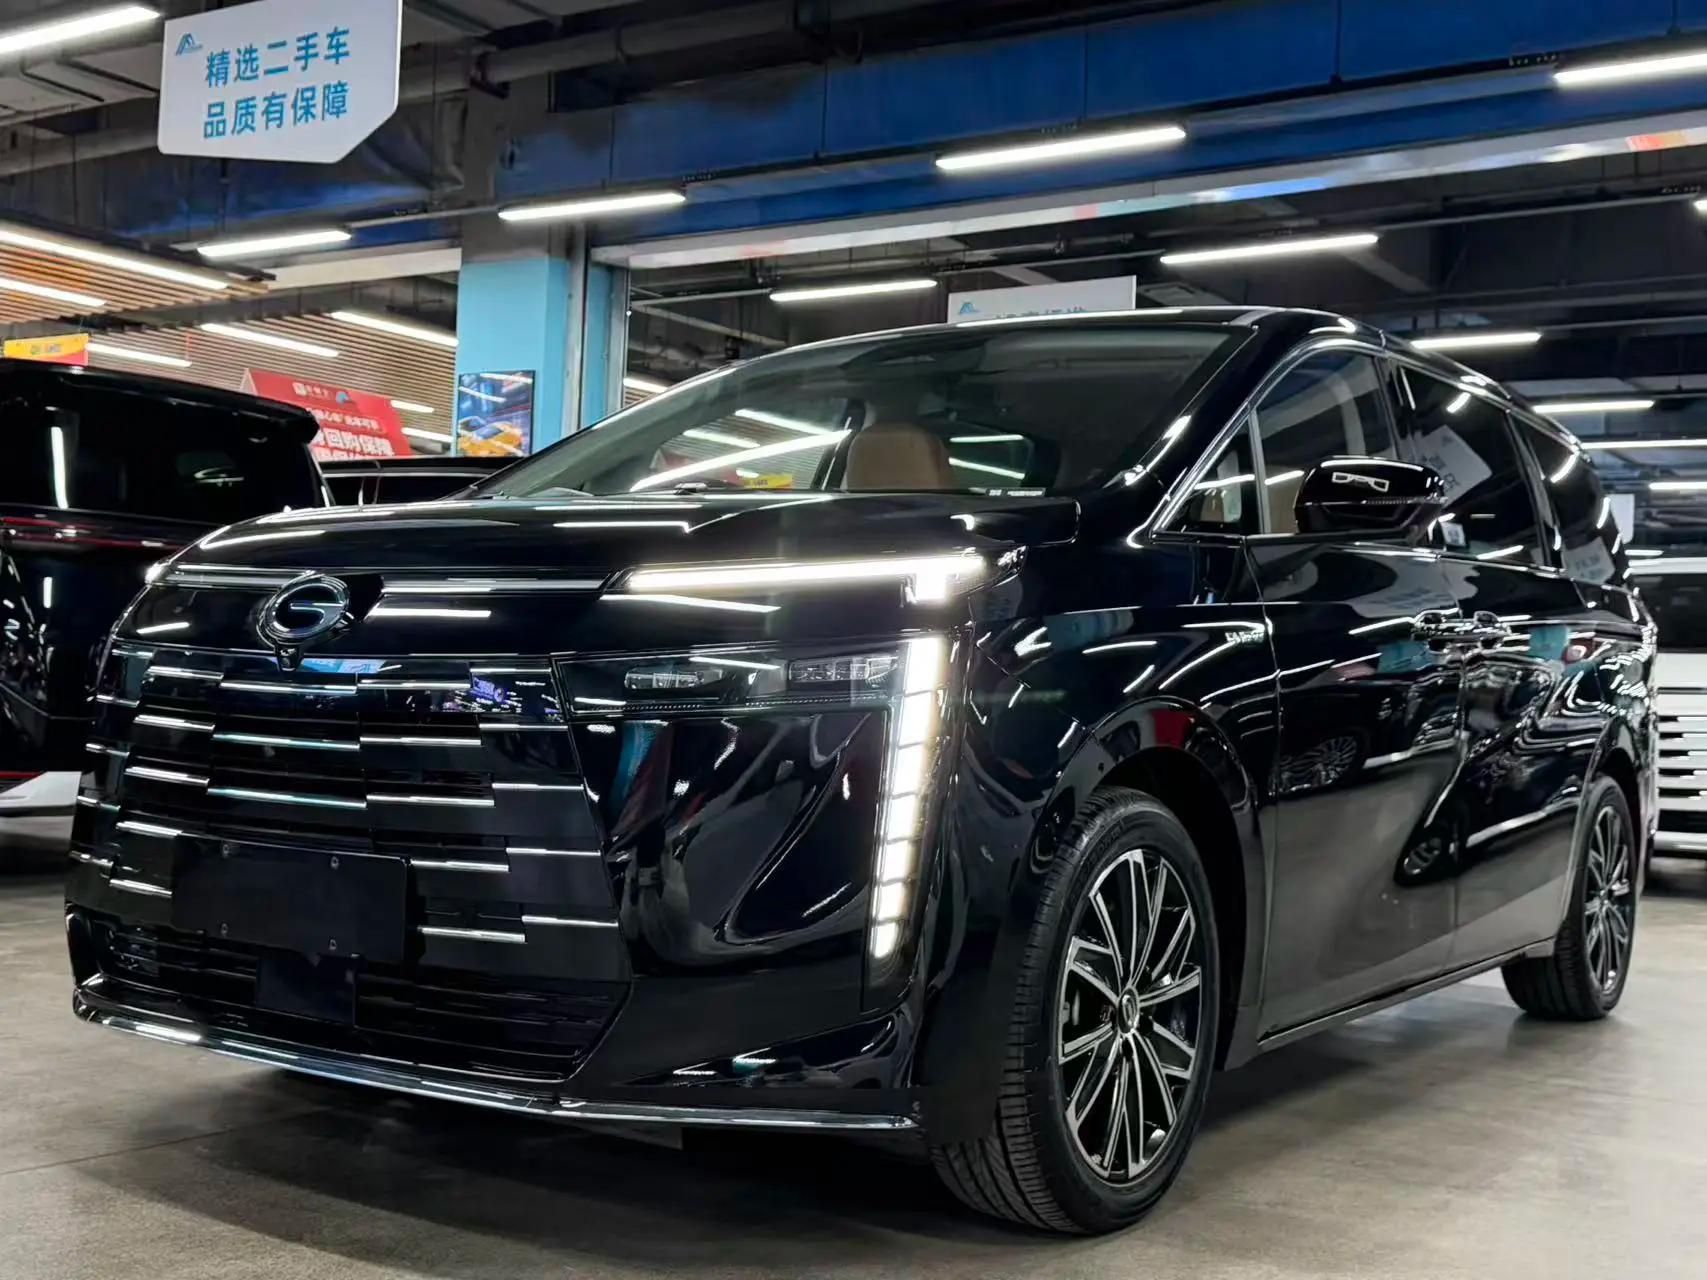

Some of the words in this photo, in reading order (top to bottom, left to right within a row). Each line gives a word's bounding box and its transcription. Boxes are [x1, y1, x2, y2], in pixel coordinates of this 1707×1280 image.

[204, 26, 350, 88] 精选二手车
[203, 80, 350, 139] 品质有保障
